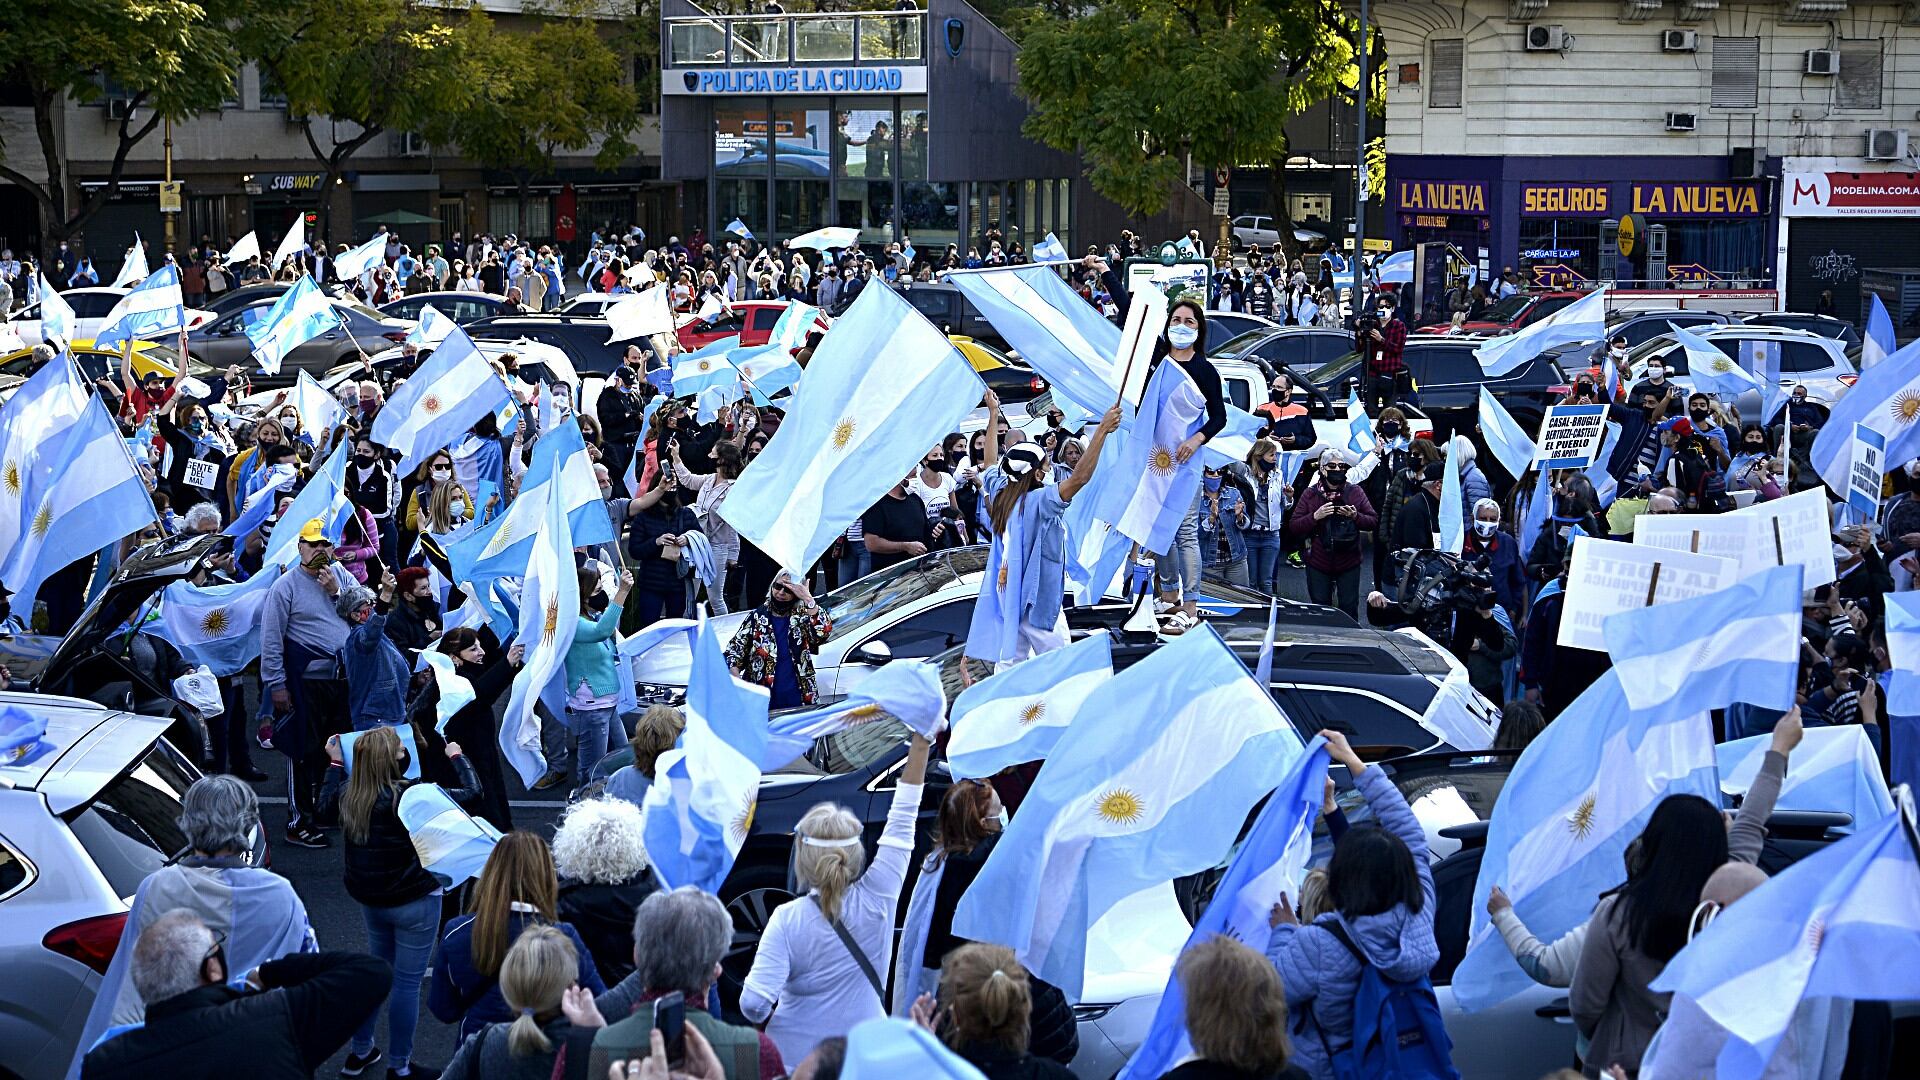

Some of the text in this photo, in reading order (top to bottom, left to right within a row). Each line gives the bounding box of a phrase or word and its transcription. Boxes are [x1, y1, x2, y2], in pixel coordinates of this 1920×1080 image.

[701, 68, 902, 92] POLICIA DE LA CIUDAD
[271, 175, 320, 190] SUBWAY
[1401, 183, 1485, 211] LA NUEVA
[1525, 187, 1607, 212] SEGUROS
[1633, 187, 1759, 213] LA NUEVA
[1525, 250, 1558, 259] CARGATE
[1560, 250, 1569, 258] LA
[1549, 416, 1602, 428] CASAL-BRUGLIA
[1545, 439, 1590, 451] EL PUEBLO
[1551, 449, 1579, 458] LOS APOYA
[1865, 447, 1876, 467] NO
[187, 460, 213, 473] GENTE
[191, 469, 204, 478] DEL
[189, 476, 203, 486] MAL
